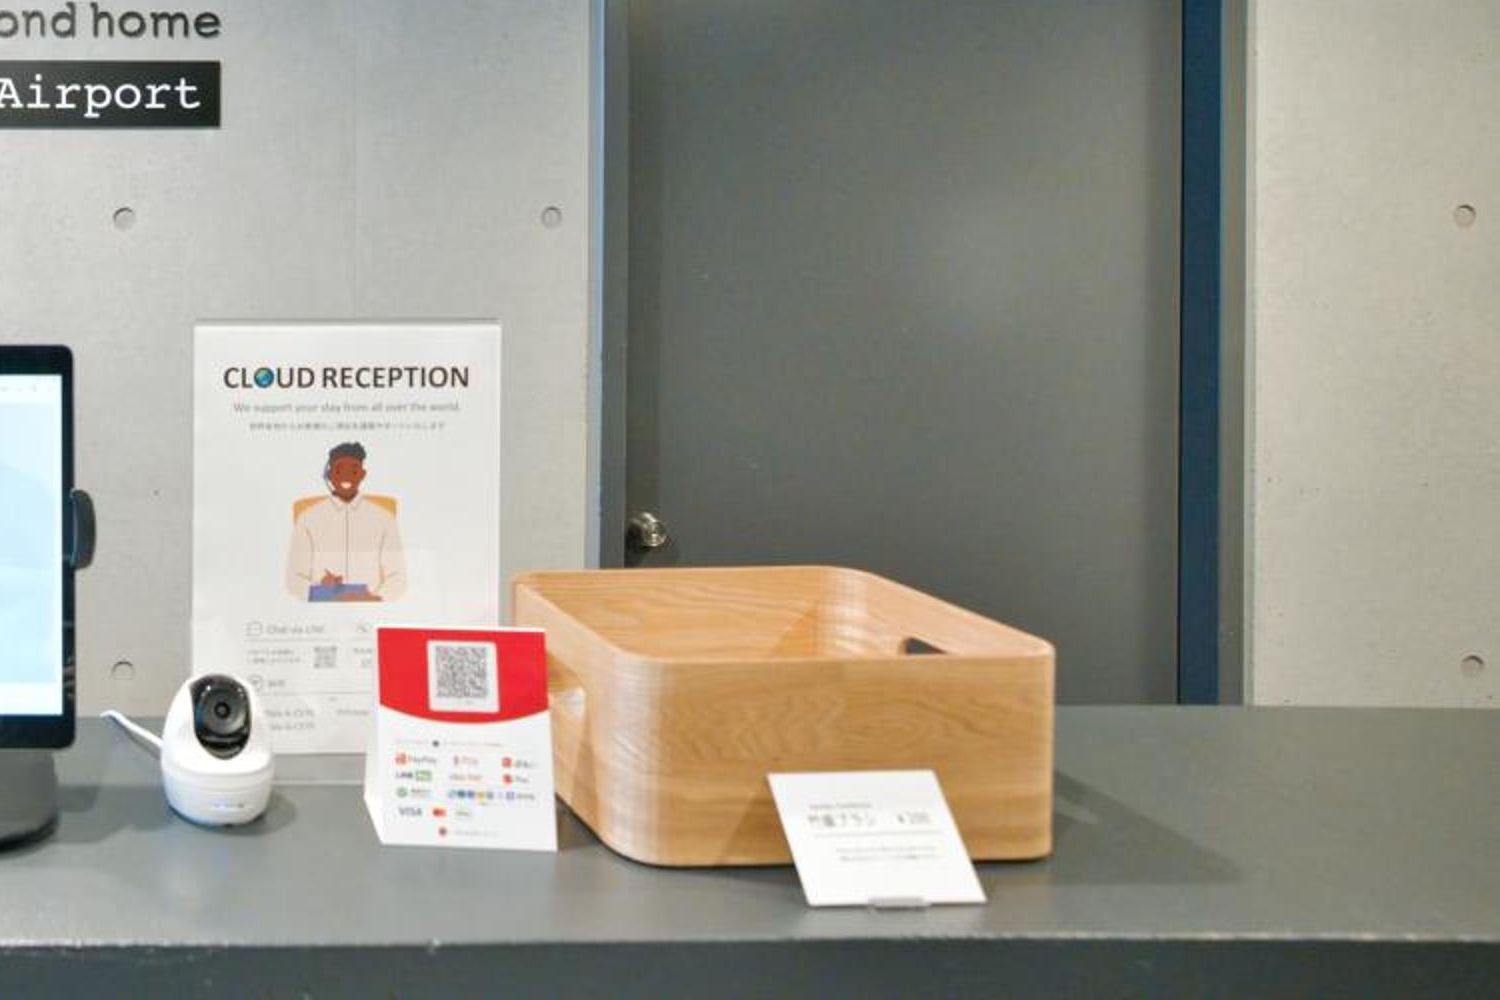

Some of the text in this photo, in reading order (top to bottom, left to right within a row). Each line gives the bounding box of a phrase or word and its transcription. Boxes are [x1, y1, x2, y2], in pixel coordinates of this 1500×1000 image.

[89, 2, 221, 39] home
[223, 366, 469, 389] CLOUD RECEPTION
